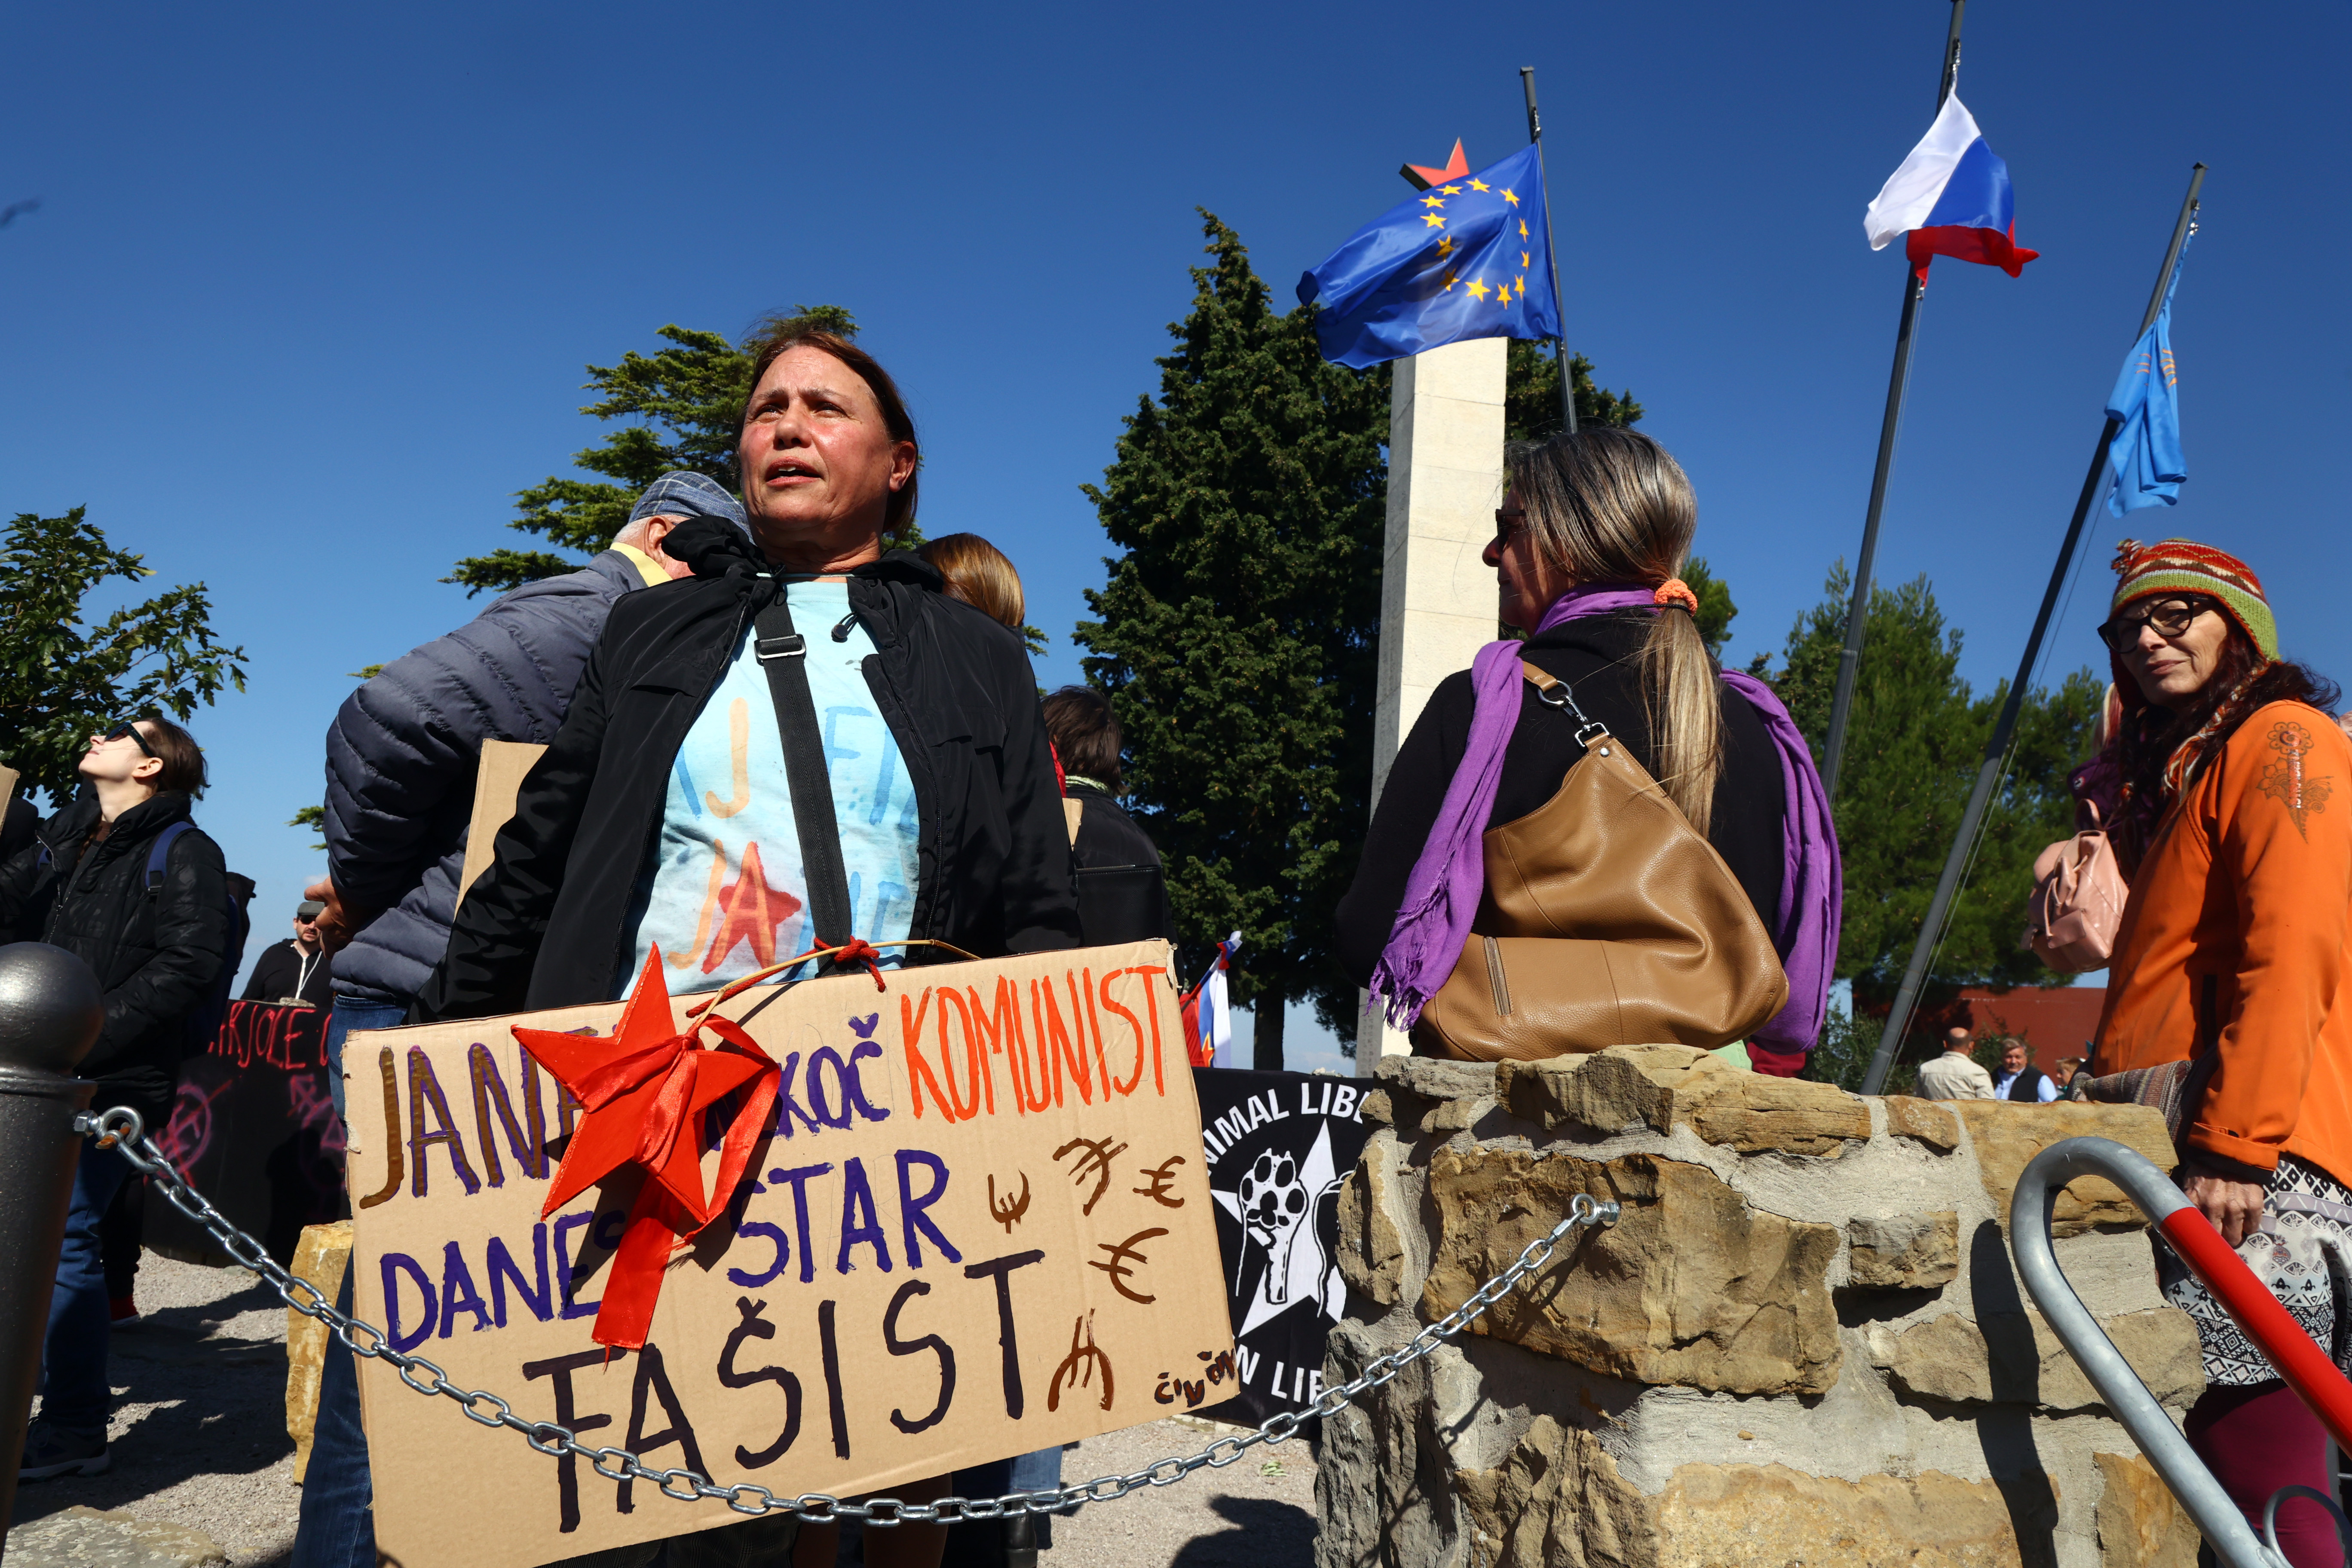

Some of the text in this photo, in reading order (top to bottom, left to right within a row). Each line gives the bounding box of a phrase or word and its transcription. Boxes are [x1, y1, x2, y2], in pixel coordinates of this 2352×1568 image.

[900, 966, 1167, 1124] KOMUNIST
[727, 1148, 963, 1288] STAR
[522, 1250, 1046, 1533] FAŠIST
